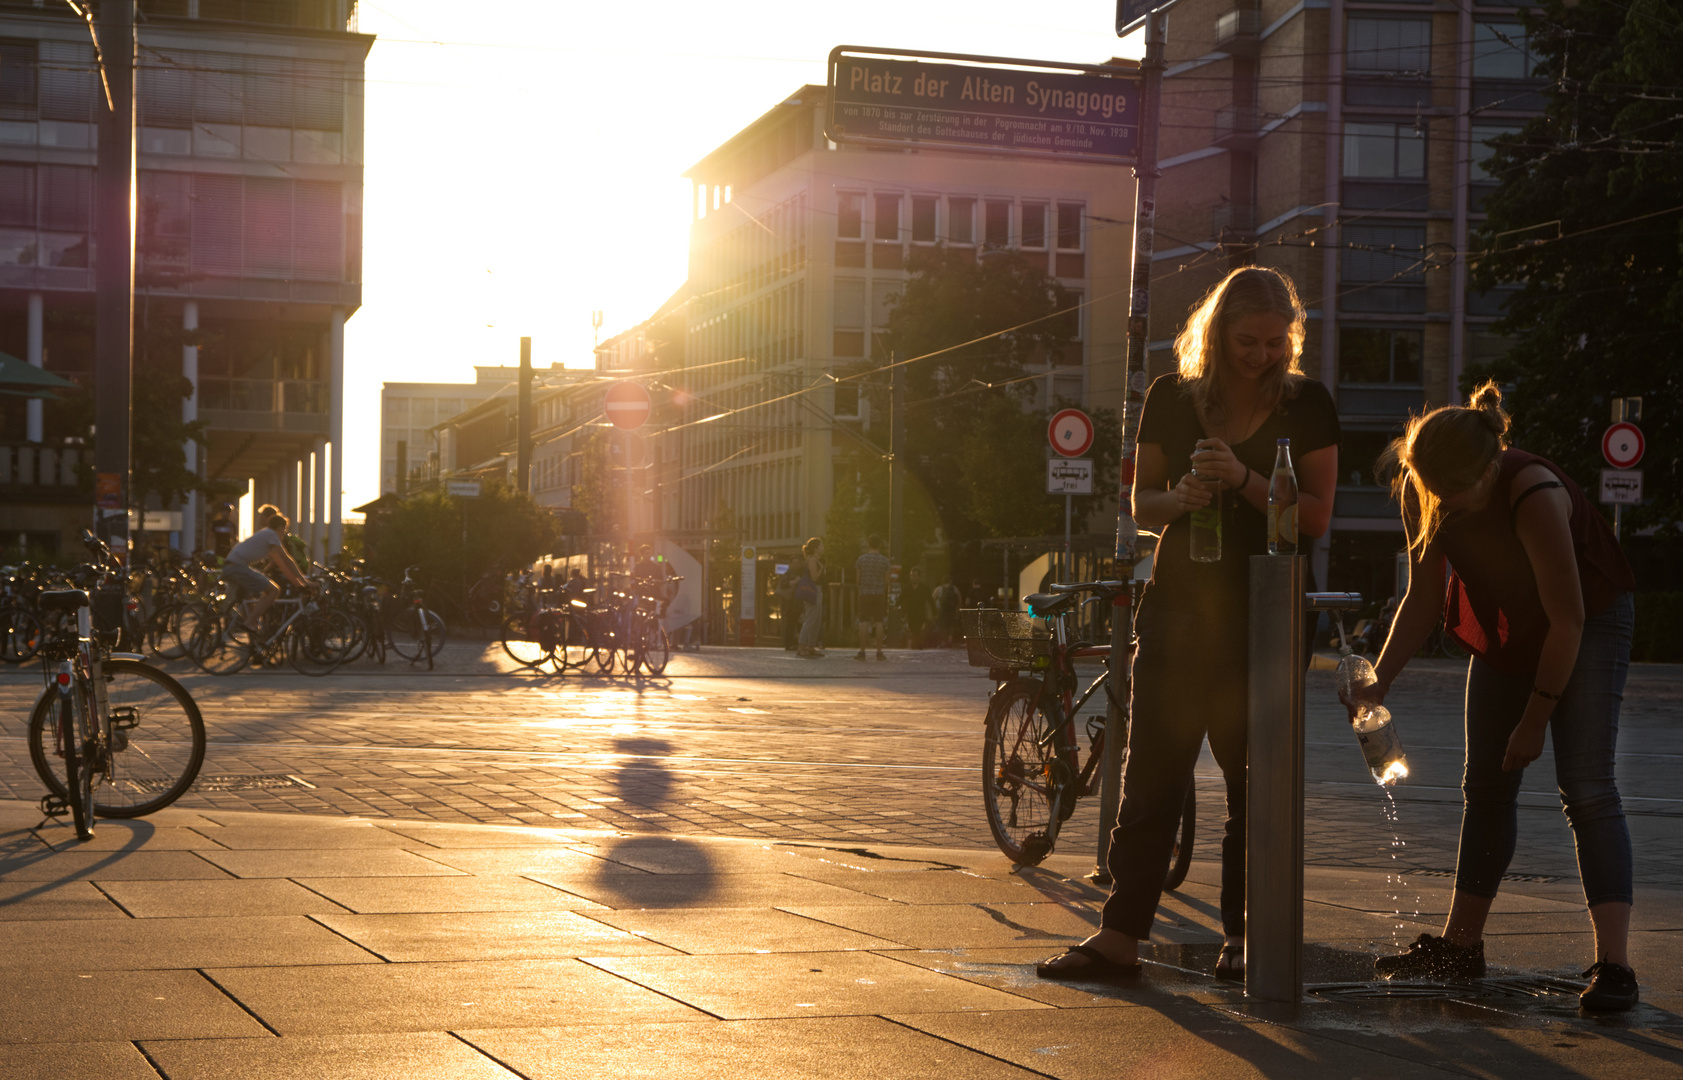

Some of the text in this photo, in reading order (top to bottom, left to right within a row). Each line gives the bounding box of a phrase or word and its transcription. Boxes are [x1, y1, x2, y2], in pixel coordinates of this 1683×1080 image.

[850, 66, 1126, 118] Platz der Alten Synagoge
[844, 106, 1129, 138] von 1870 bis zur Zerstörung in der Pogromnacht am 9./10. Nov. 1938
[879, 120, 1093, 148] Standort des Gotteshauses der jüdischen Gemeinde
[1063, 481, 1078, 489] frei
[1615, 491, 1628, 499] frei
